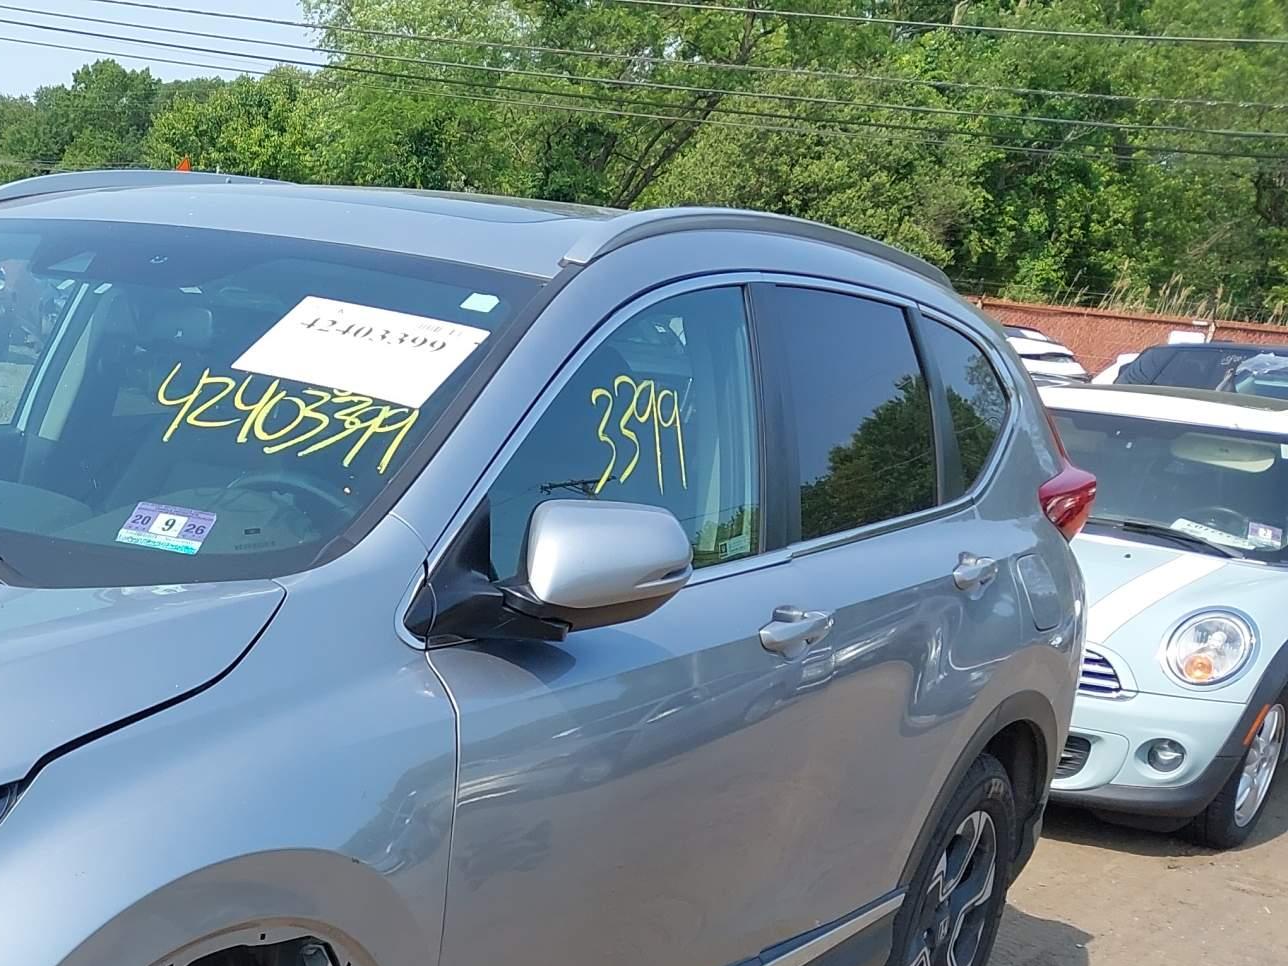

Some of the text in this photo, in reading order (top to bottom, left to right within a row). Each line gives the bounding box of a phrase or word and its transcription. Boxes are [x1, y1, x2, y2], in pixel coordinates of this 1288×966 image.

[300, 316, 448, 353] 42403399
[157, 362, 420, 475] 42403399
[591, 374, 689, 496] 3399
[131, 514, 207, 536] 20 9 26
